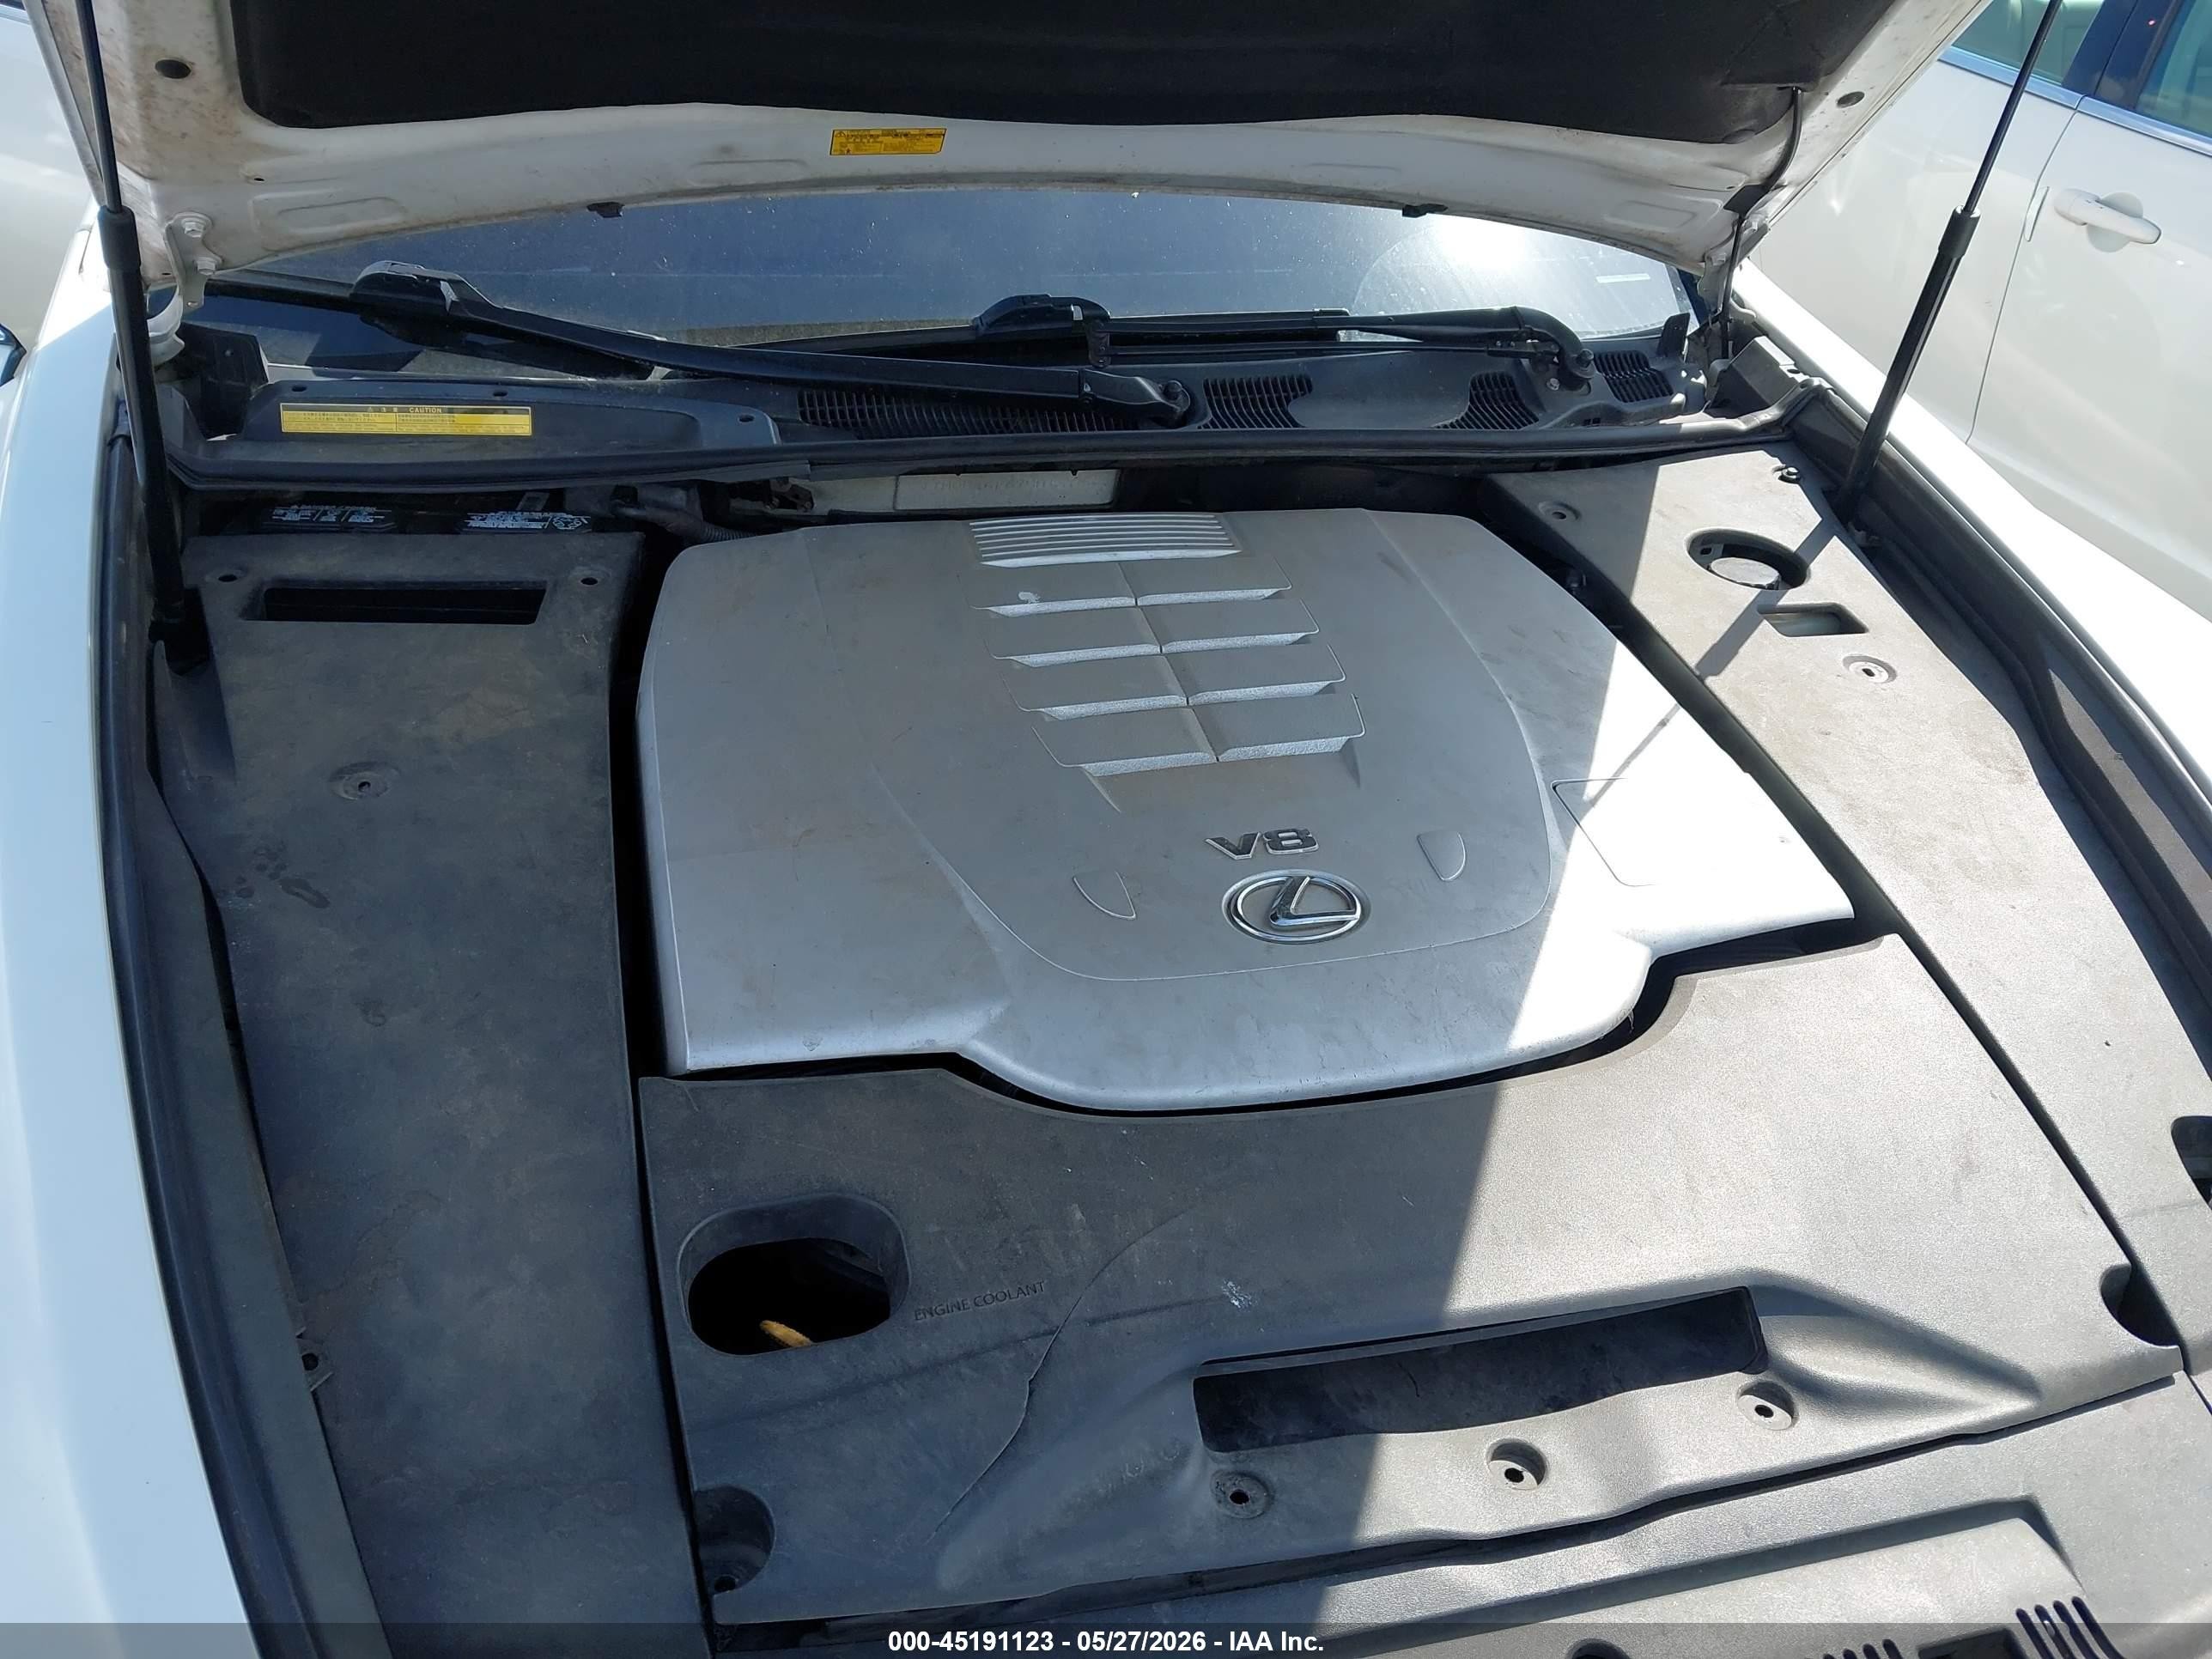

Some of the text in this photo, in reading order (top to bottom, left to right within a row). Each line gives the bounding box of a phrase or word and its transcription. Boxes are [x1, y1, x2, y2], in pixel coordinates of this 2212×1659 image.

[1205, 829, 1320, 860] V8
[914, 1280, 1045, 1321] ENGINE COOLANT
